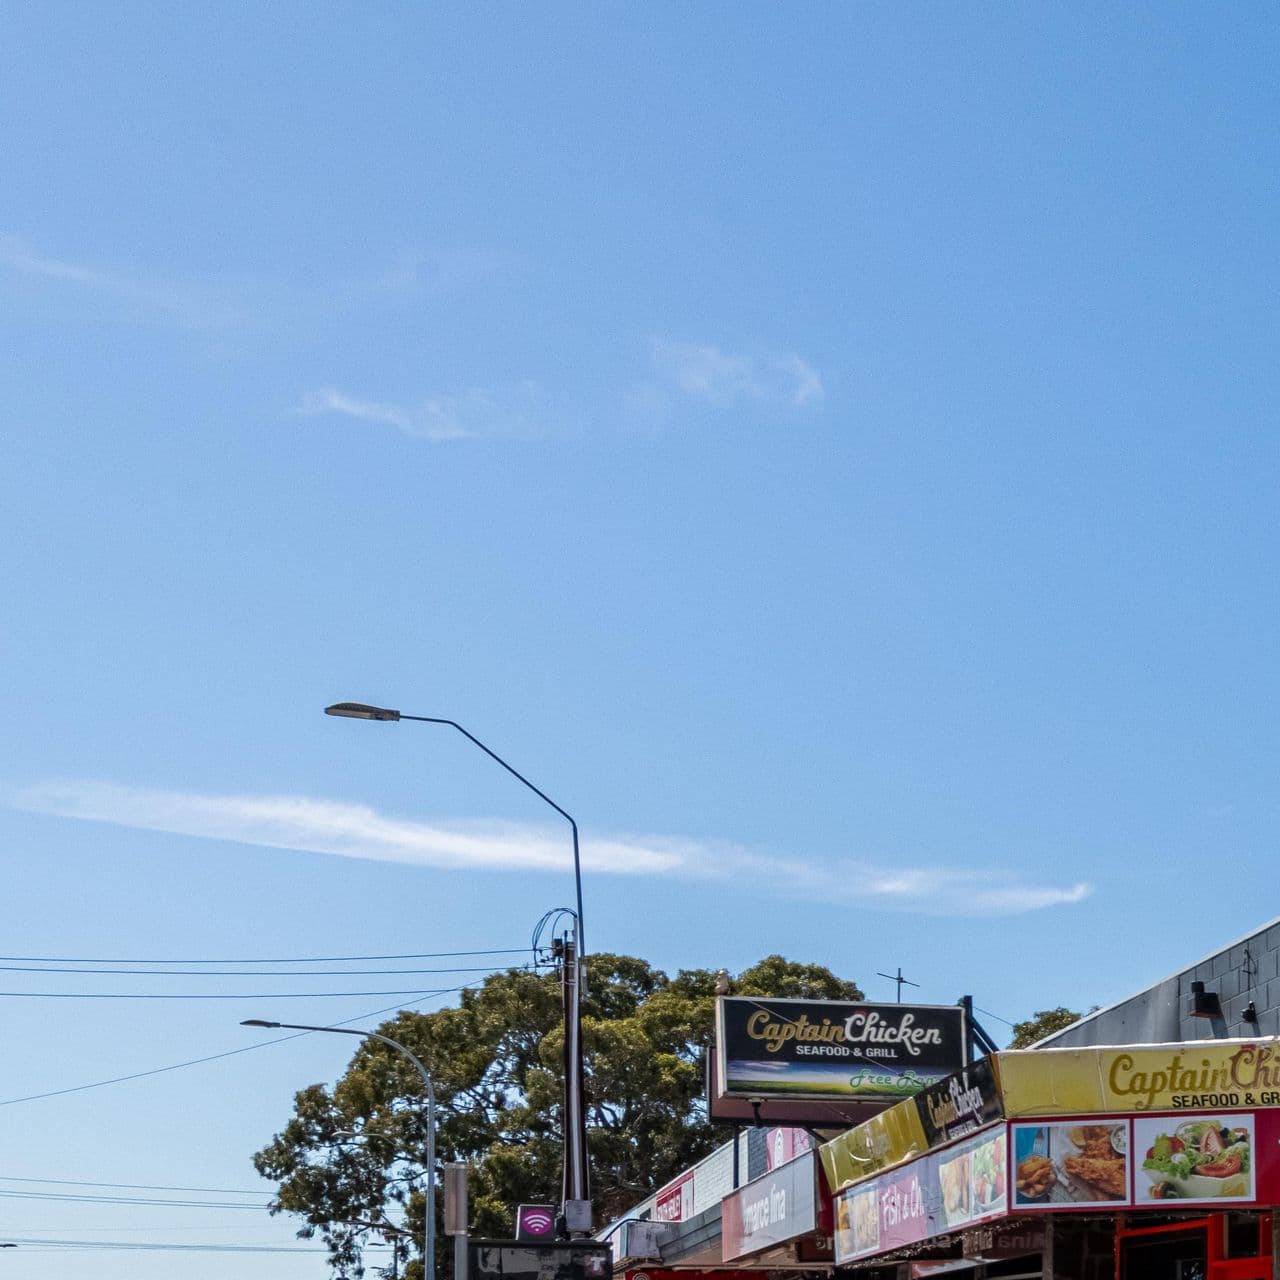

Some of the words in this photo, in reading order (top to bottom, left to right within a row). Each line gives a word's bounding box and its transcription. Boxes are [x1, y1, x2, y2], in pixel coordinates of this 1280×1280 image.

[796, 1045, 850, 1057] SEAFOOD
[853, 1048, 862, 1056] &
[865, 1047, 898, 1058] GRILL
[850, 1068, 892, 1088] Free
[896, 1070, 938, 1090] Ran
[1172, 1093, 1239, 1108] SEAFOOD
[1244, 1092, 1255, 1105] &
